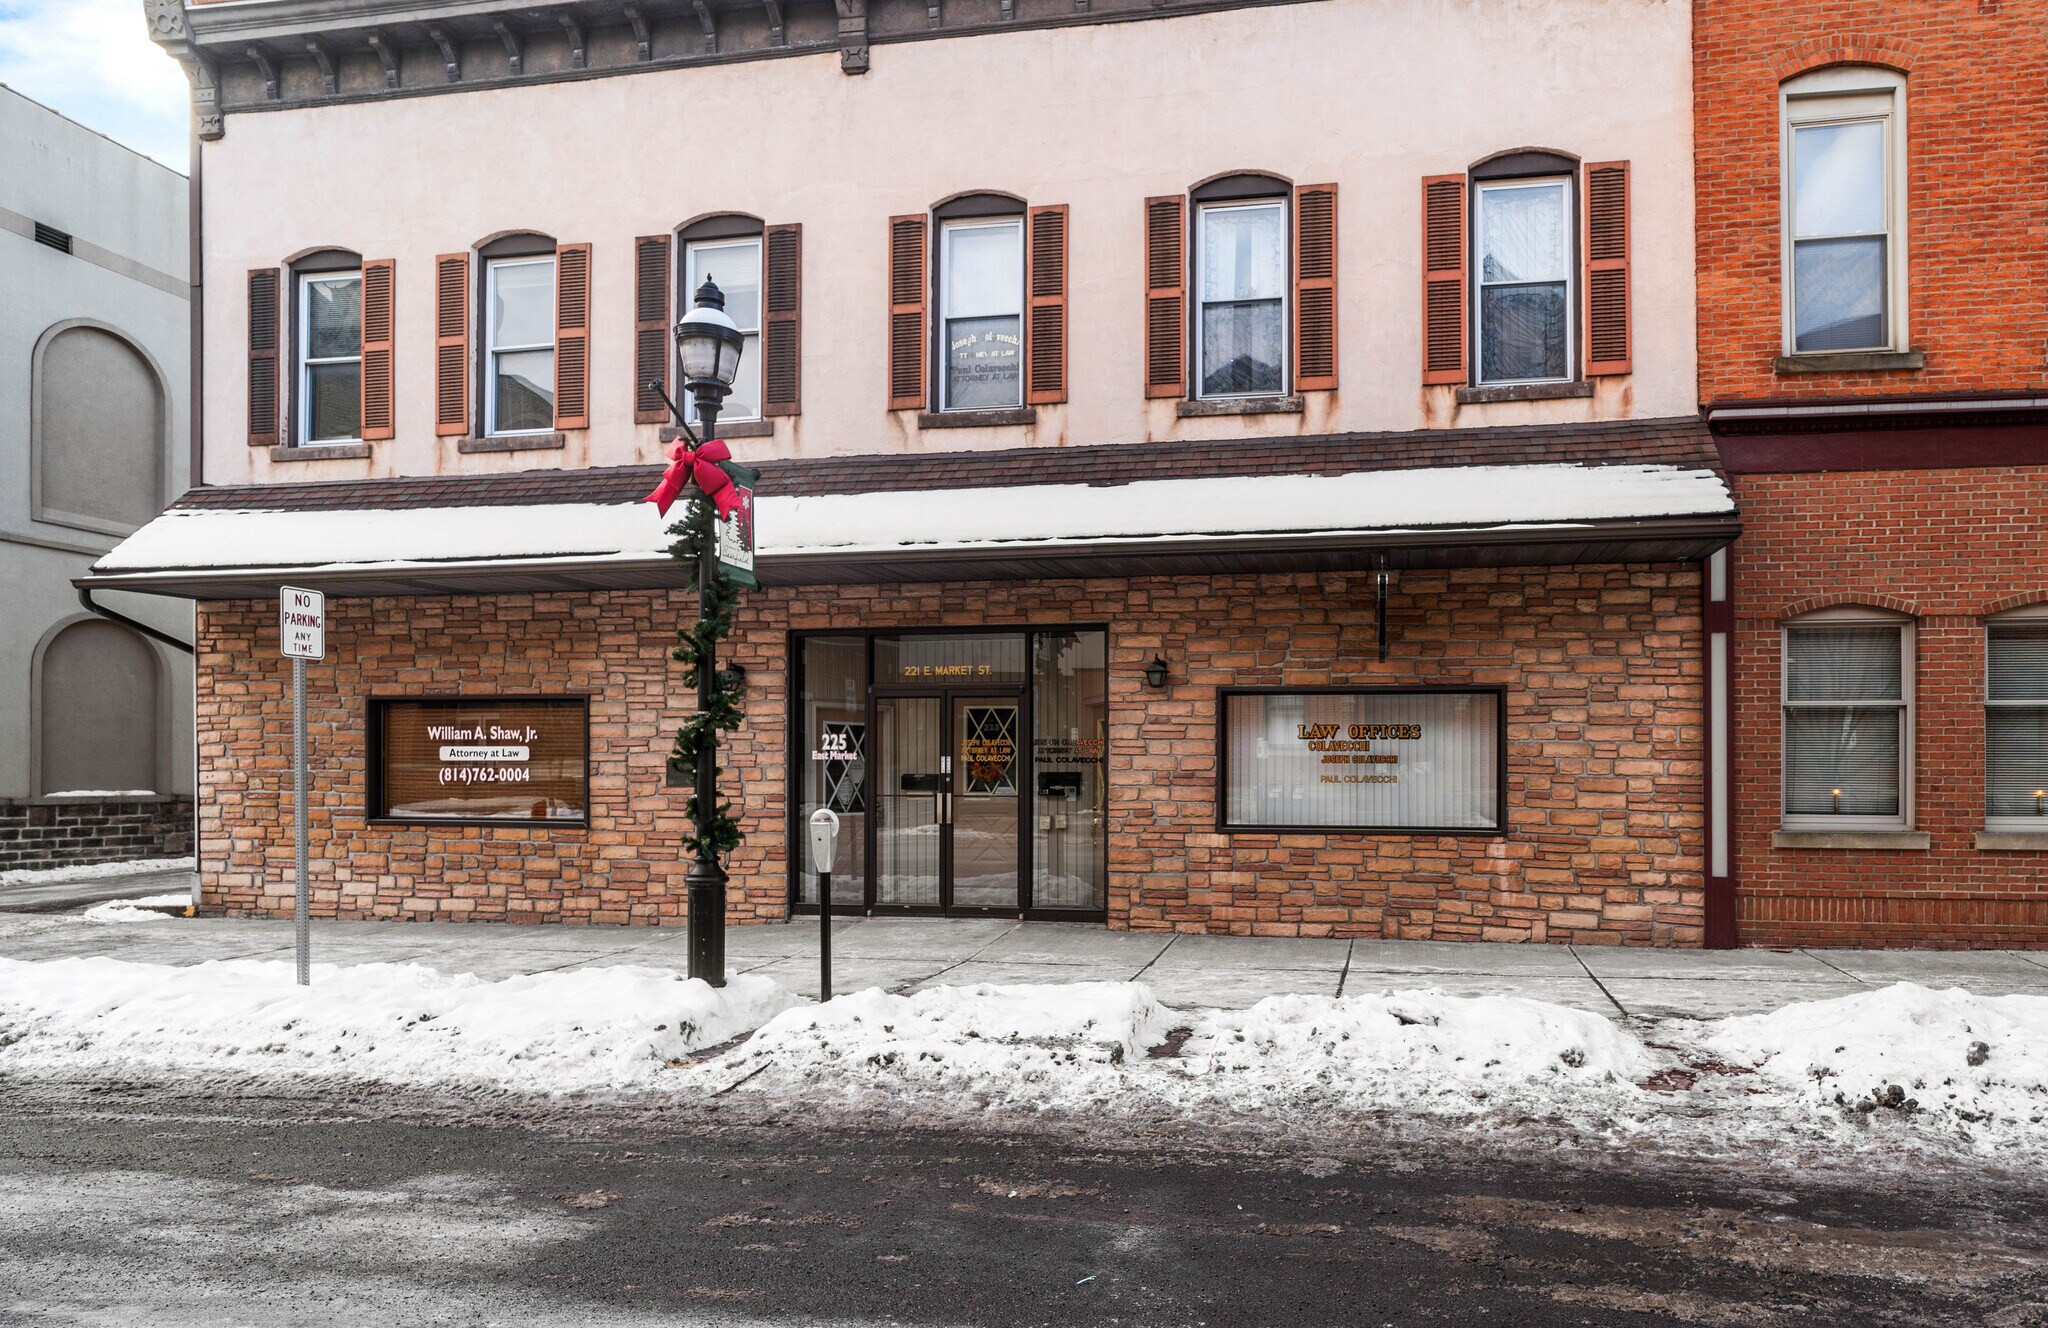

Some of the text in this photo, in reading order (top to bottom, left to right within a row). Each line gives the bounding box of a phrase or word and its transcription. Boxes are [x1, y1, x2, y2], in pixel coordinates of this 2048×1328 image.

[951, 332, 1020, 350] Joseph olvecch
[1001, 349, 1016, 357] LAW
[951, 372, 1020, 383] ATTORNEY AT LAW
[295, 594, 310, 607] NO
[285, 612, 320, 628] PARKING
[295, 632, 311, 641] ANY
[293, 643, 312, 653] TIME
[904, 665, 993, 676] 221 E. MARKET ST.
[427, 725, 538, 743] William A. Shaw, Jr.
[1298, 723, 1422, 740] LAW OFFICES
[821, 733, 847, 751] 225
[1308, 740, 1370, 752] COLAVECCHI
[449, 748, 520, 760] Attorney at Law
[811, 750, 858, 760] East Market
[1320, 755, 1398, 764] JOSEPH COLAVECCHI
[438, 767, 530, 786] (814)762-0004
[1320, 775, 1398, 783] PAUL COLAVECCHI
